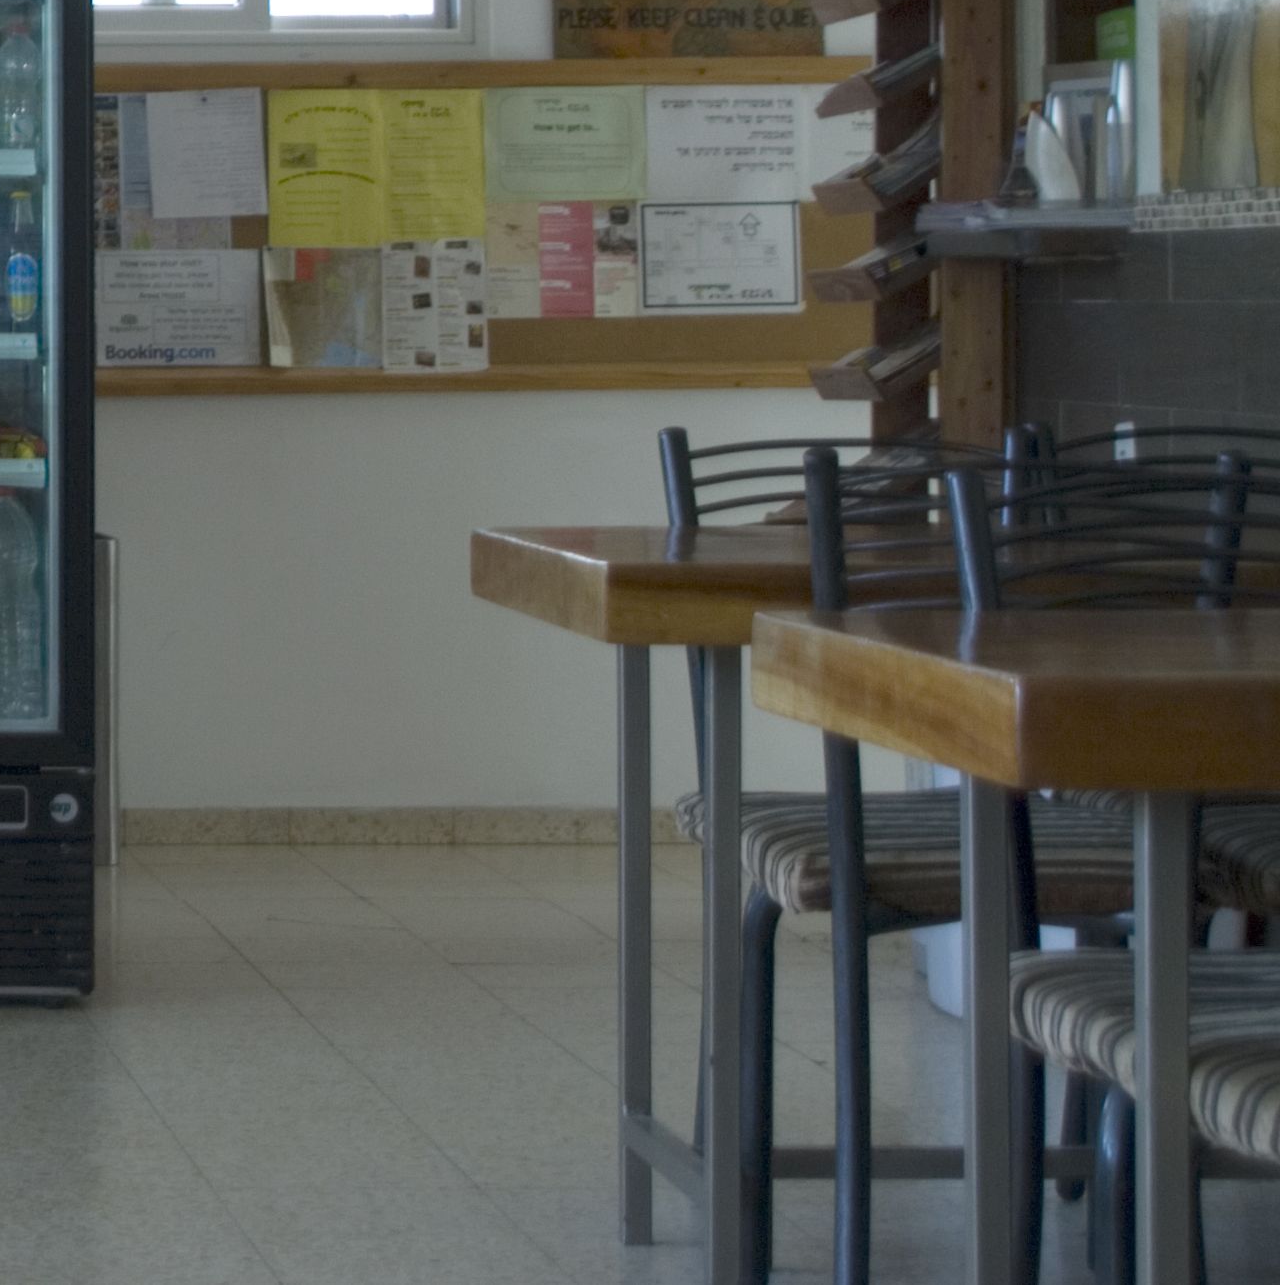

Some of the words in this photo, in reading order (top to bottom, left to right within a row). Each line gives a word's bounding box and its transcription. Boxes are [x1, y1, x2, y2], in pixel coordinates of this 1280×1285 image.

[557, 7, 618, 30] PLEASE
[627, 6, 677, 34] KEEP
[105, 345, 217, 363] Booking.com
